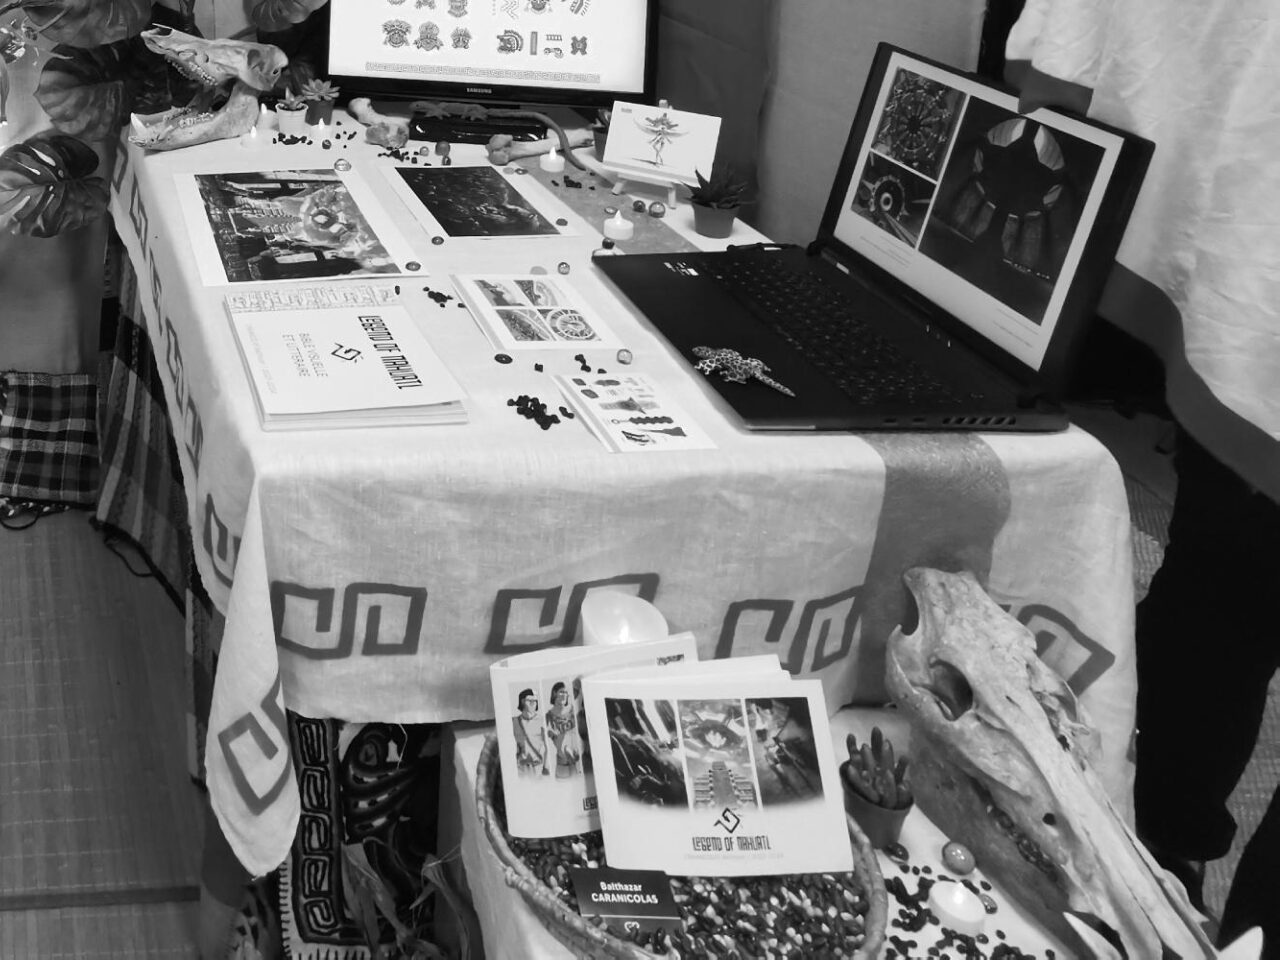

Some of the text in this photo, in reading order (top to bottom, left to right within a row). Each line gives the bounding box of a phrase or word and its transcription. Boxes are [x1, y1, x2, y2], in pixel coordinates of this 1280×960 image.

[373, 343, 402, 353] OF
[723, 836, 734, 851] OF
[600, 881, 642, 892] Balthazar
[591, 893, 659, 904] CARANICOLAS
